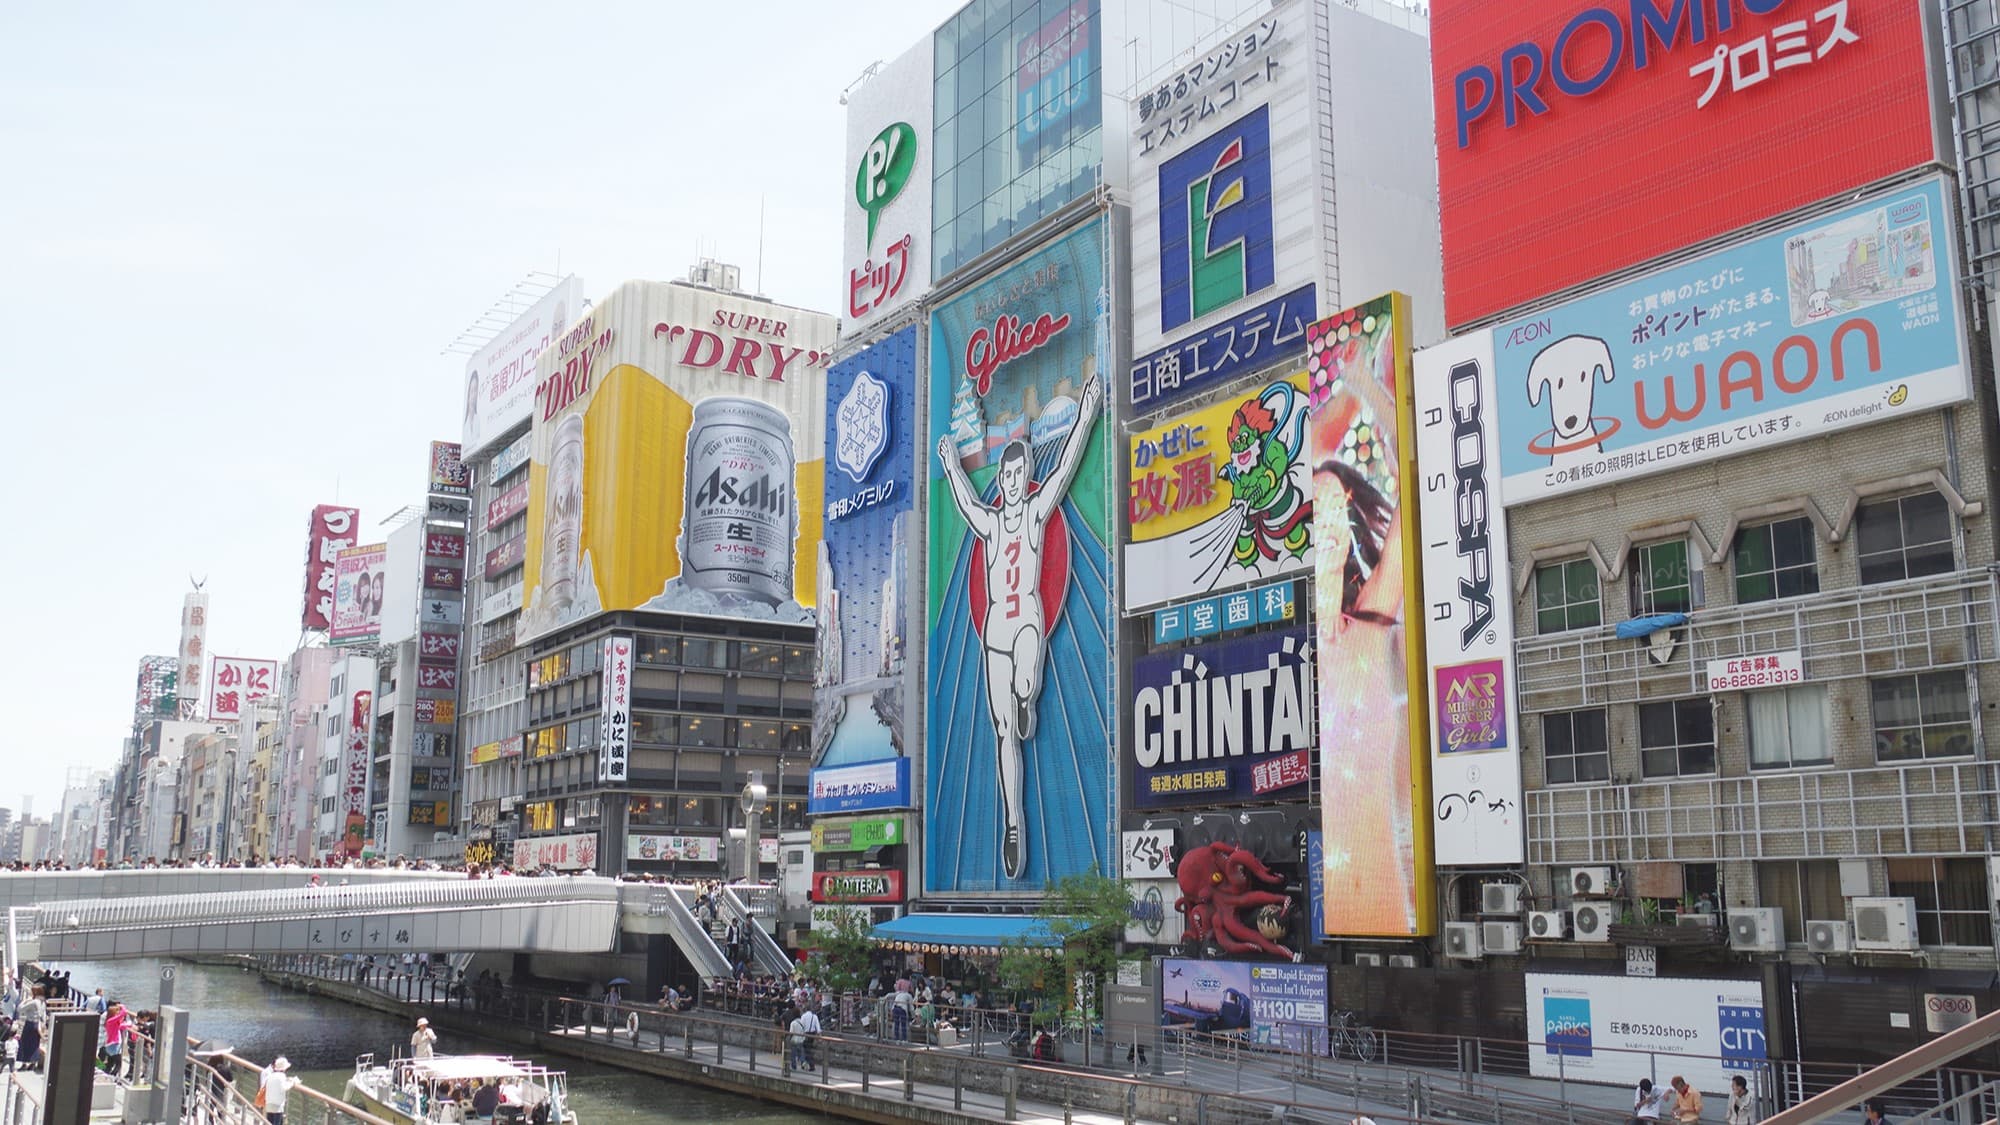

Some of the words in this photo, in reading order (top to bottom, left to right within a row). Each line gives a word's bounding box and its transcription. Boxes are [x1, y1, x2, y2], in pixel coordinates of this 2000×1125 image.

[1139, 19, 1277, 124] 夢あるマンション
[1689, 0, 1860, 110] プロミス
[1454, 0, 1786, 150] PROM
[1140, 56, 1278, 157] エステムコート
[850, 233, 911, 319] ピップ
[1628, 266, 1745, 317] お買物のたびに
[559, 316, 592, 361] SUPER
[712, 308, 788, 338] SUPER
[1902, 313, 1940, 331] WAON
[965, 311, 1071, 397] Glico
[1130, 301, 1304, 405] 日商エステム
[1632, 319, 1773, 370] おトクな電子マネー
[1633, 316, 1881, 432] WAON
[1849, 400, 1883, 420] delight
[1134, 422, 1207, 469] かぜに
[1544, 413, 1803, 488] この看板の照明はLEDを使用しています。
[695, 466, 785, 518] Asahi
[828, 479, 894, 521] 雪印メグミルク
[1128, 451, 1217, 525] 改源
[727, 522, 753, 542] 生
[1424, 406, 1452, 622] ASIA
[714, 543, 766, 558] スーパードライ
[727, 573, 750, 585] 350ml
[1004, 535, 1022, 619] グリコ
[1160, 586, 1287, 638] 戸堂歯科
[218, 663, 270, 690] かに
[615, 659, 627, 706] 本場の味
[1711, 669, 1799, 690] 06-6262-1313
[1727, 655, 1780, 674] 広告募集
[1446, 672, 1497, 702] MR
[1447, 698, 1495, 714] MILLION
[1452, 709, 1493, 725] RACER
[610, 710, 626, 777] かに道楽
[1447, 725, 1497, 751] Girls
[1253, 759, 1283, 792] 賃貸
[1282, 754, 1298, 770] 住宅
[1283, 765, 1309, 783] ニュース
[1151, 769, 1227, 793] 毎週水曜日発売
[1132, 835, 1164, 871] くくる
[1626, 947, 1656, 962] BAR
[1252, 984, 1260, 993] to
[1261, 982, 1283, 995] Kansai
[1299, 985, 1325, 998] Airport
[1278, 968, 1298, 983] Rapid
[1299, 969, 1325, 986] Express
[1610, 1021, 1698, 1041] 圧巻の520shops
